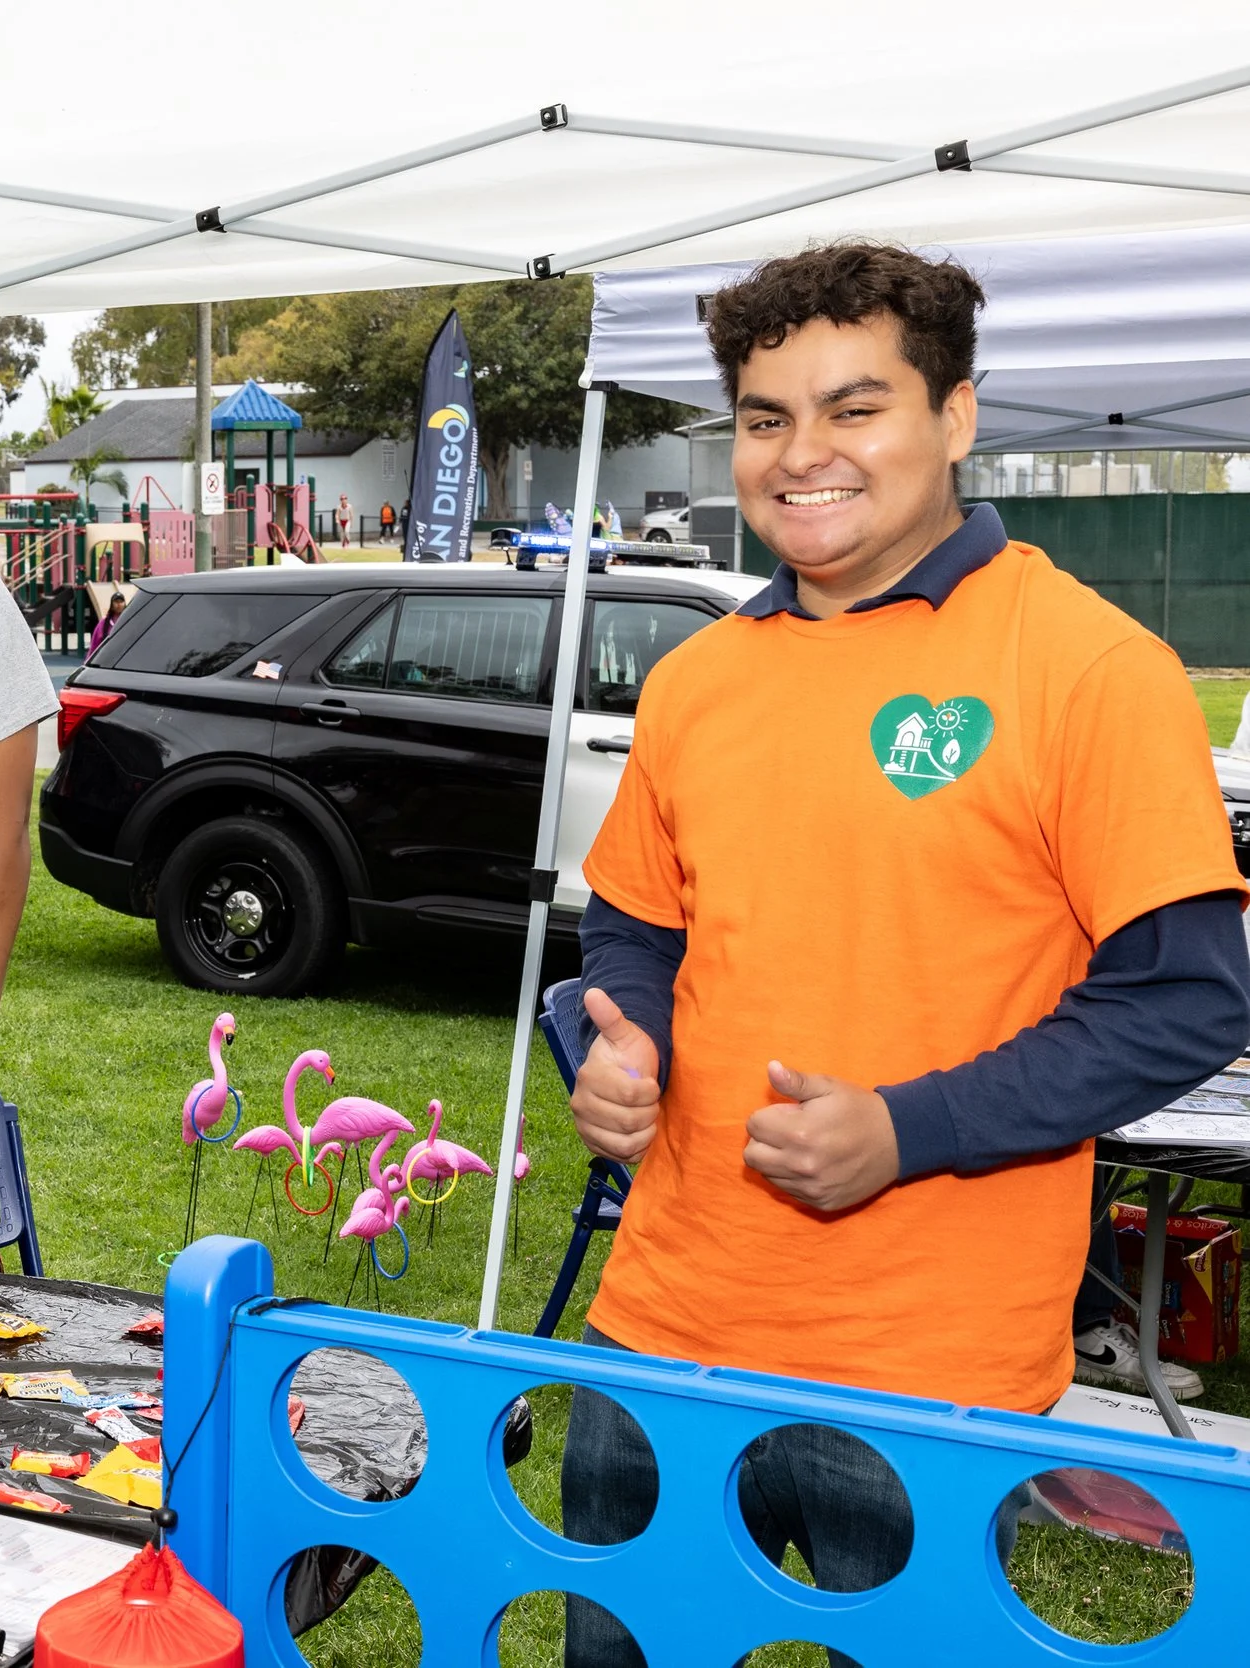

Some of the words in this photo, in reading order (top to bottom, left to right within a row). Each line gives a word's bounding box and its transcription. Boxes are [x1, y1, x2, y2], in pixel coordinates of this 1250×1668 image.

[432, 419, 466, 516] DIEGO
[466, 427, 479, 485] Department
[416, 519, 428, 534] of
[459, 486, 476, 537] Recreation
[458, 540, 469, 558] and
